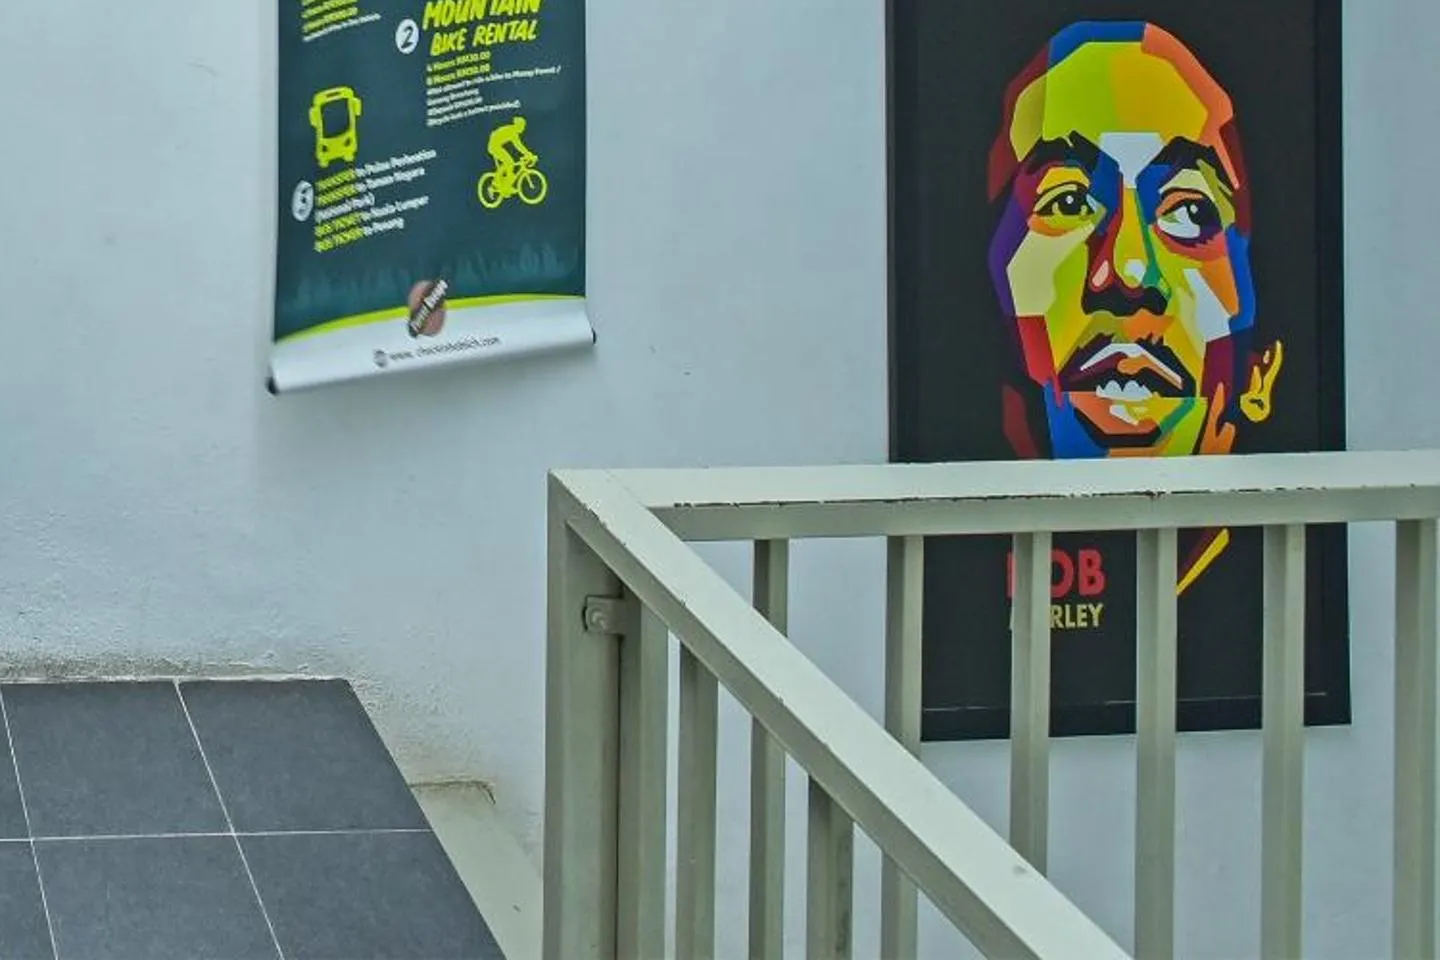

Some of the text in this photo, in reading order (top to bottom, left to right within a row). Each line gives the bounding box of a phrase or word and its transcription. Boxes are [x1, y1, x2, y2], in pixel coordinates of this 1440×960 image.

[430, 19, 538, 56] BIKE RENTAL
[1006, 548, 1106, 598] OB
